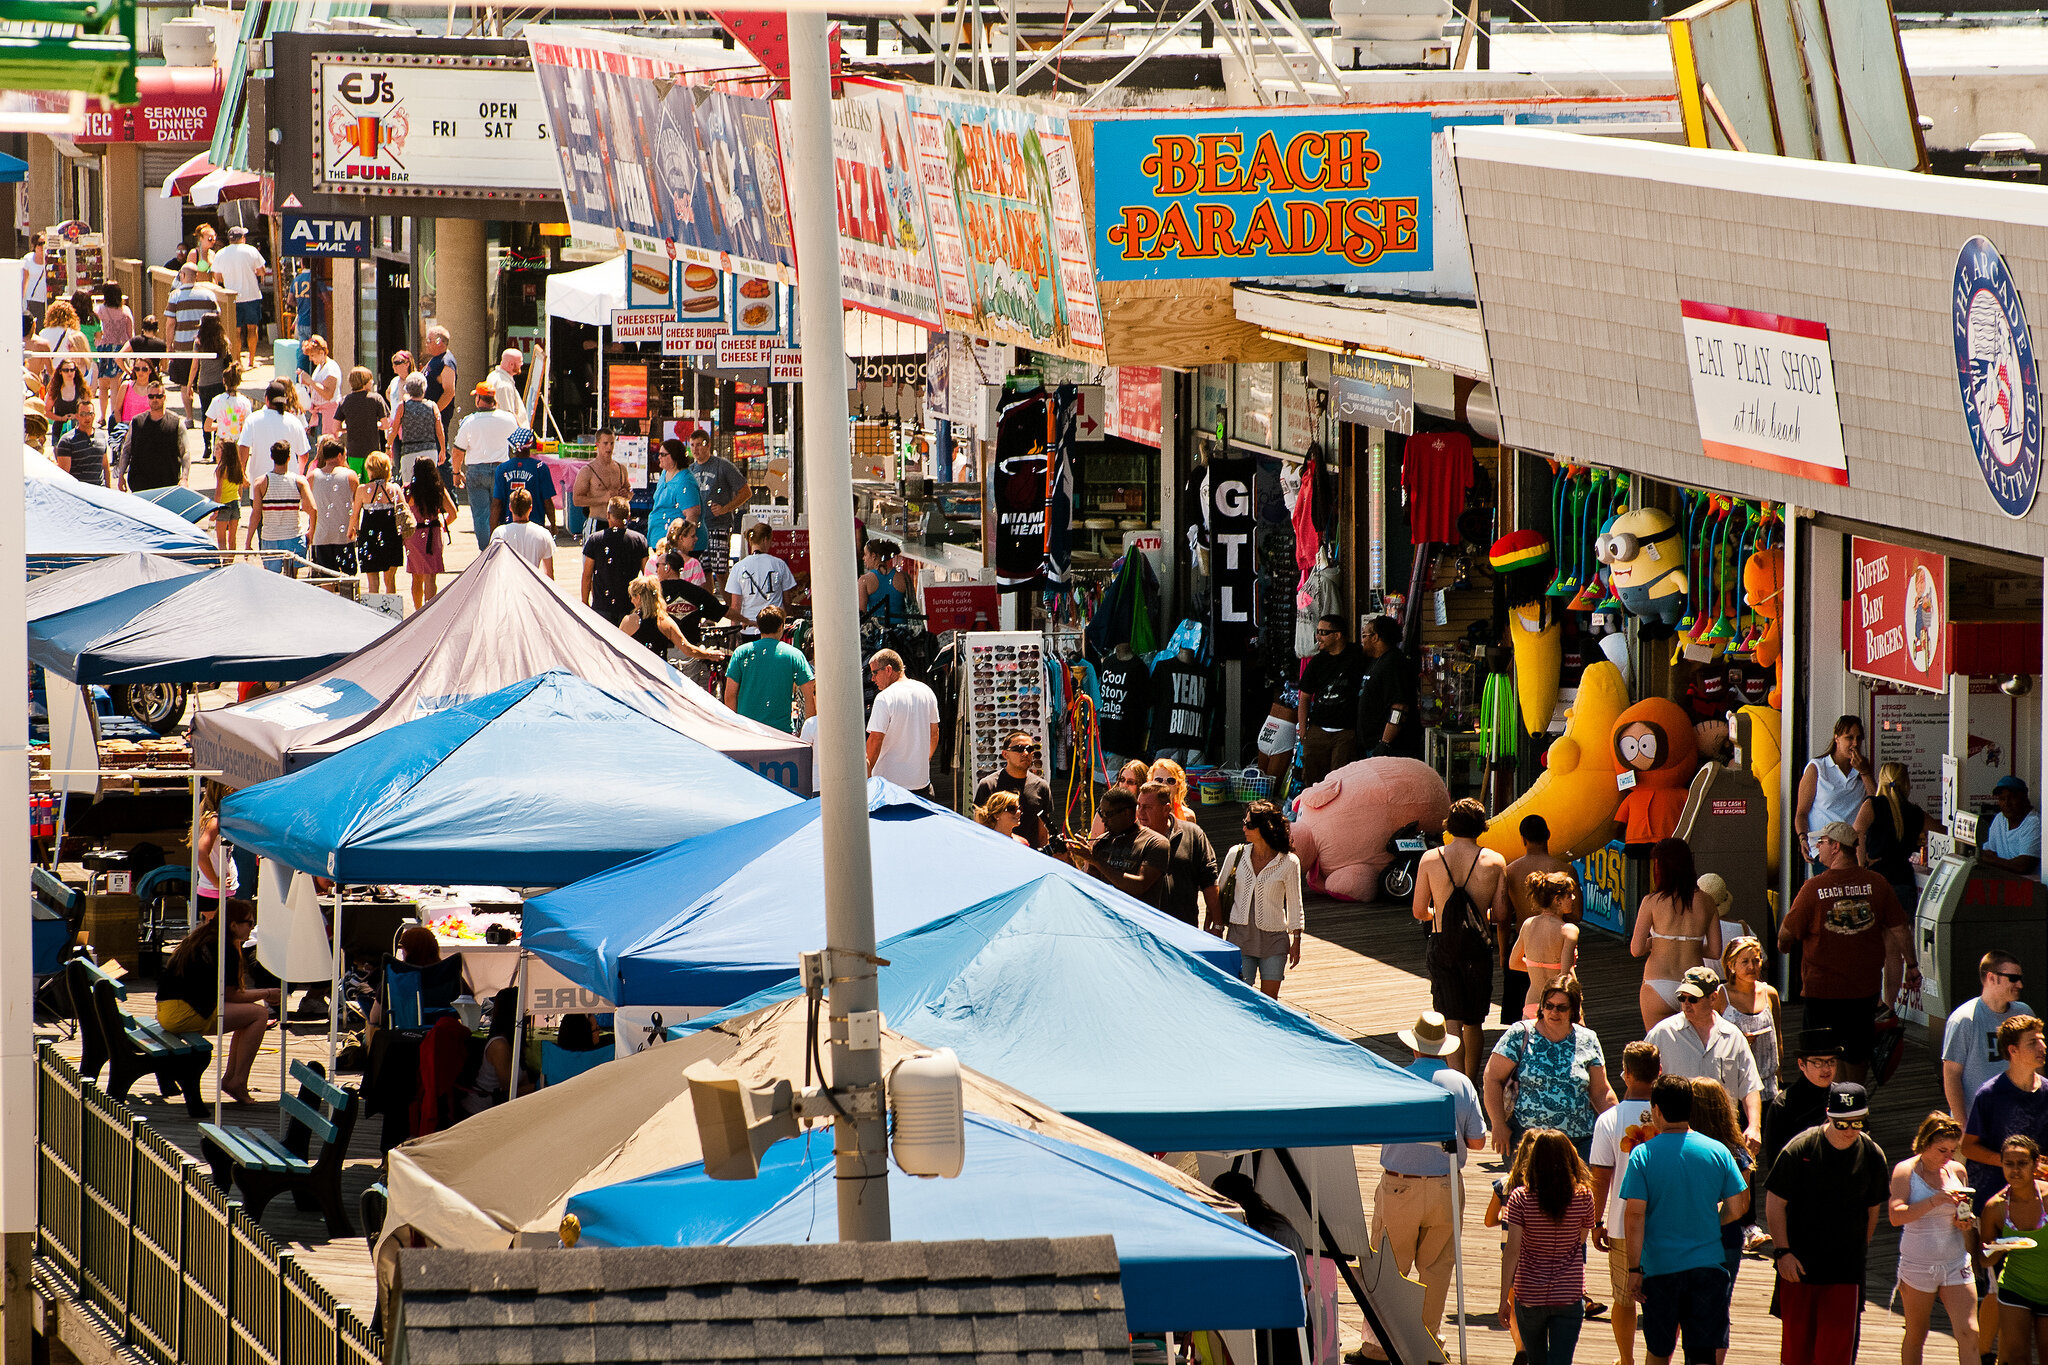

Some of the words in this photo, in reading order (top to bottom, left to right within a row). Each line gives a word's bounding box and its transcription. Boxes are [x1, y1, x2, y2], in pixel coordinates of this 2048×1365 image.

[144, 106, 207, 118] SERVING
[479, 103, 517, 119] OPEN
[149, 118, 204, 130] DINNER
[432, 120, 456, 137] FRI
[485, 122, 512, 138] SAT
[538, 123, 551, 139] S
[157, 130, 196, 141] DAILY
[961, 122, 1027, 200] BEACH
[1142, 130, 1381, 196] BEACH
[328, 170, 346, 180] THE
[346, 165, 391, 180] FUN
[391, 172, 409, 181] BAR
[290, 220, 361, 241] ATM
[1107, 196, 1419, 266] PARADISE
[316, 242, 346, 252] MAC
[966, 198, 1049, 294] PARADISE
[294, 281, 310, 298] 12
[1956, 265, 1972, 338] THE
[1974, 253, 2028, 357] ARCADE
[617, 326, 645, 337] ITALIAN
[666, 328, 695, 338] CHEESE
[666, 340, 690, 350] HOT
[721, 340, 757, 350] CHEESE
[721, 352, 758, 363] CHEESE
[1695, 336, 1725, 377] EAT
[1733, 342, 1772, 386] PLAY
[1781, 350, 1822, 395] SHOP
[774, 367, 803, 377] FRIE
[1733, 401, 1746, 432] at
[1749, 397, 1766, 437] the
[1769, 401, 1801, 443] beach
[1962, 386, 2037, 503] MARKETPLACE
[504, 470, 533, 482] ANTHONY
[1001, 511, 1044, 525] MIAMI
[1010, 522, 1046, 535] HEAT
[1102, 669, 1127, 685] Cool
[1101, 684, 1128, 702] Story
[1818, 886, 1843, 899] BEACH
[1845, 884, 1872, 896] COOLER
[1965, 879, 2033, 907] ATM
[1586, 882, 1612, 919] Wins!
[1839, 1093, 1854, 1107] NJ
